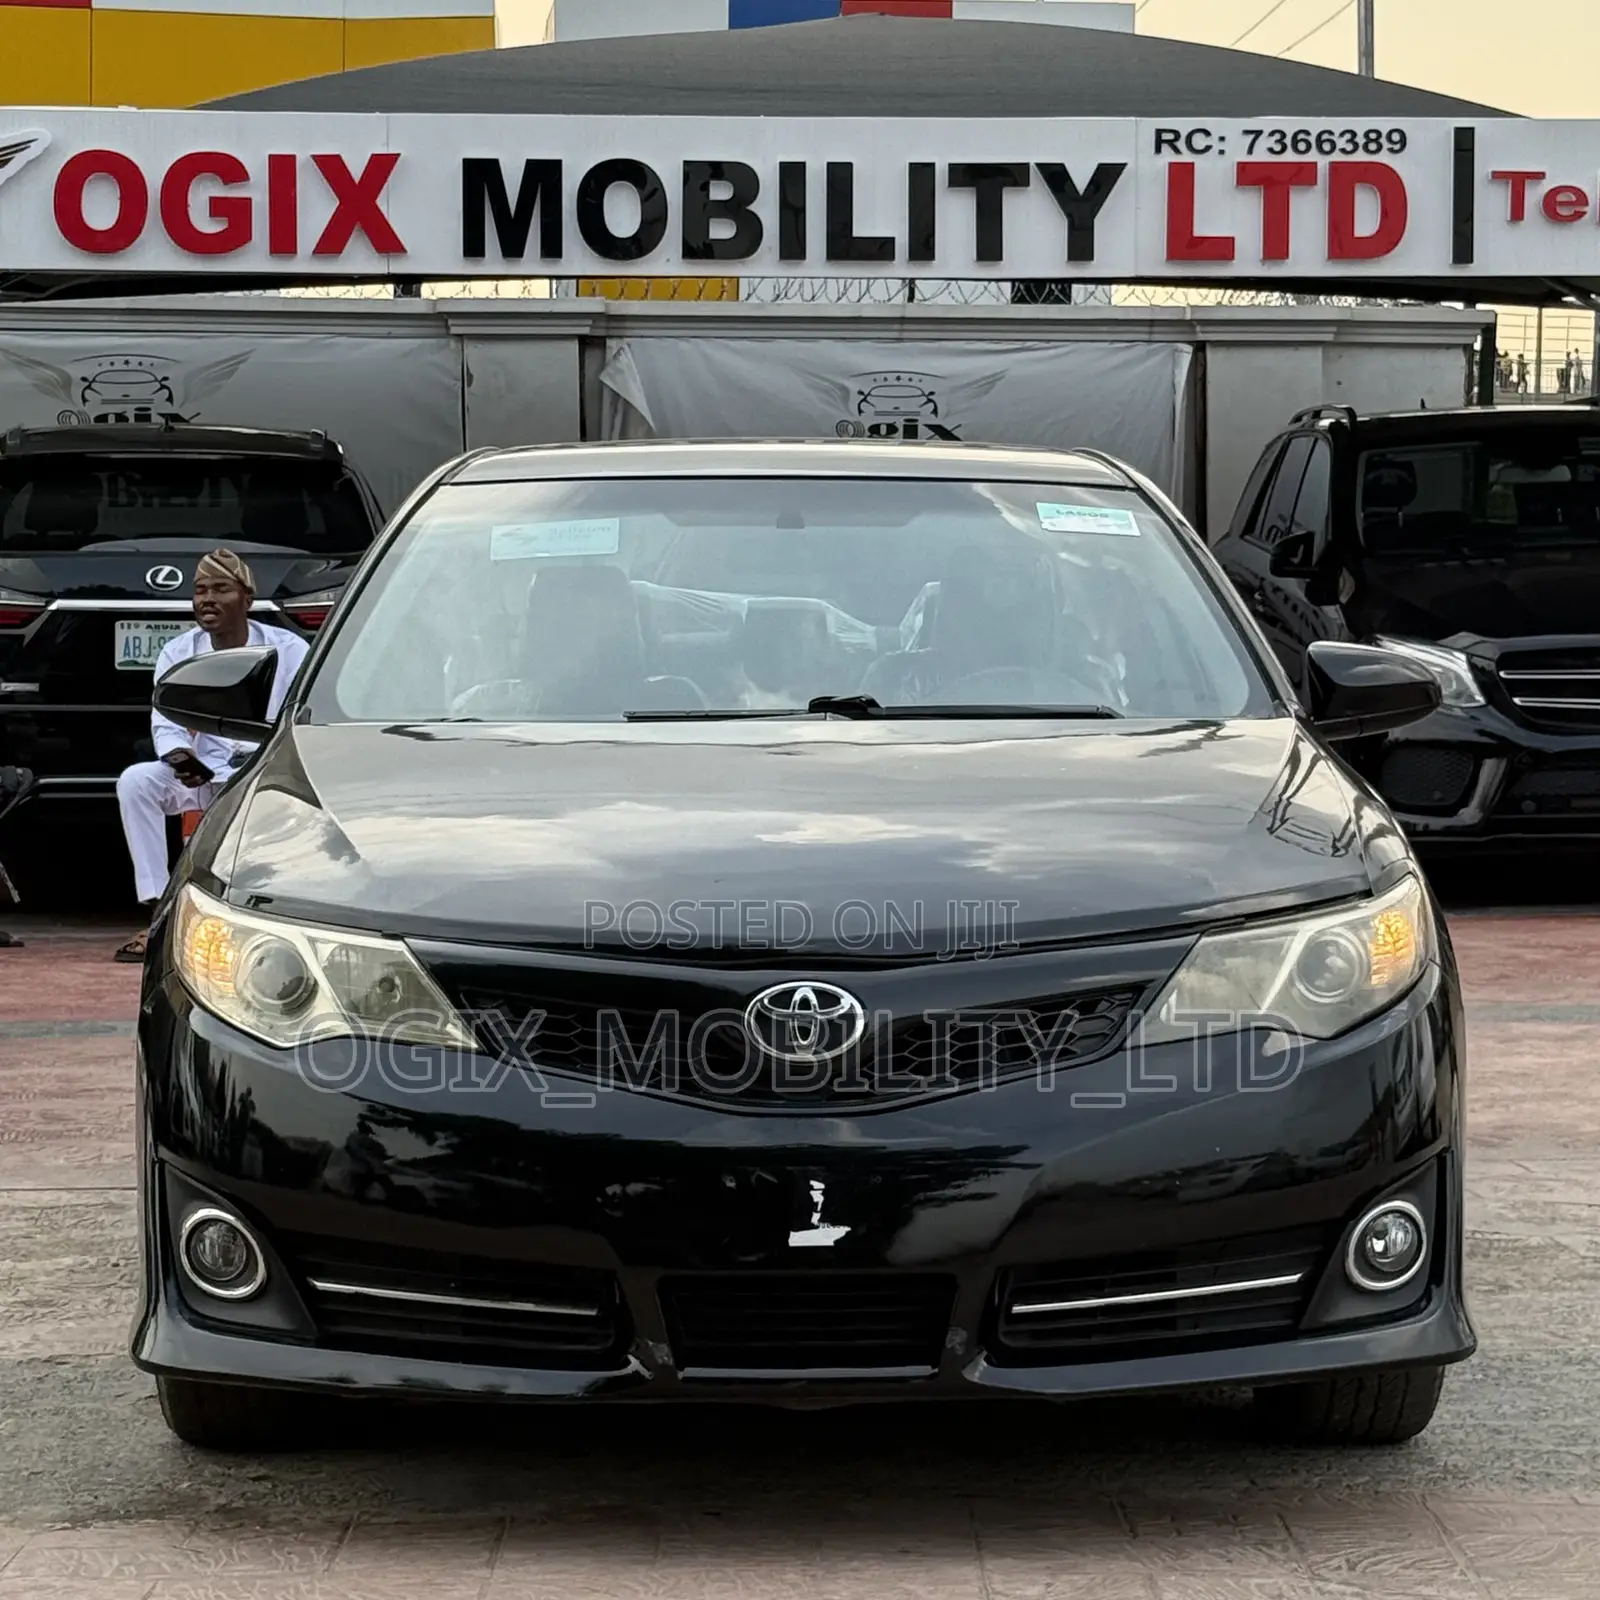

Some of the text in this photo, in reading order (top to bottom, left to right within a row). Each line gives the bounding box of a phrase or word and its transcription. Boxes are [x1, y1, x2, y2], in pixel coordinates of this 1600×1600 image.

[1153, 128, 1407, 155] RC: 7366389
[53, 149, 1409, 263] OGIX MOBILITY LTD
[1489, 169, 1600, 226] Te
